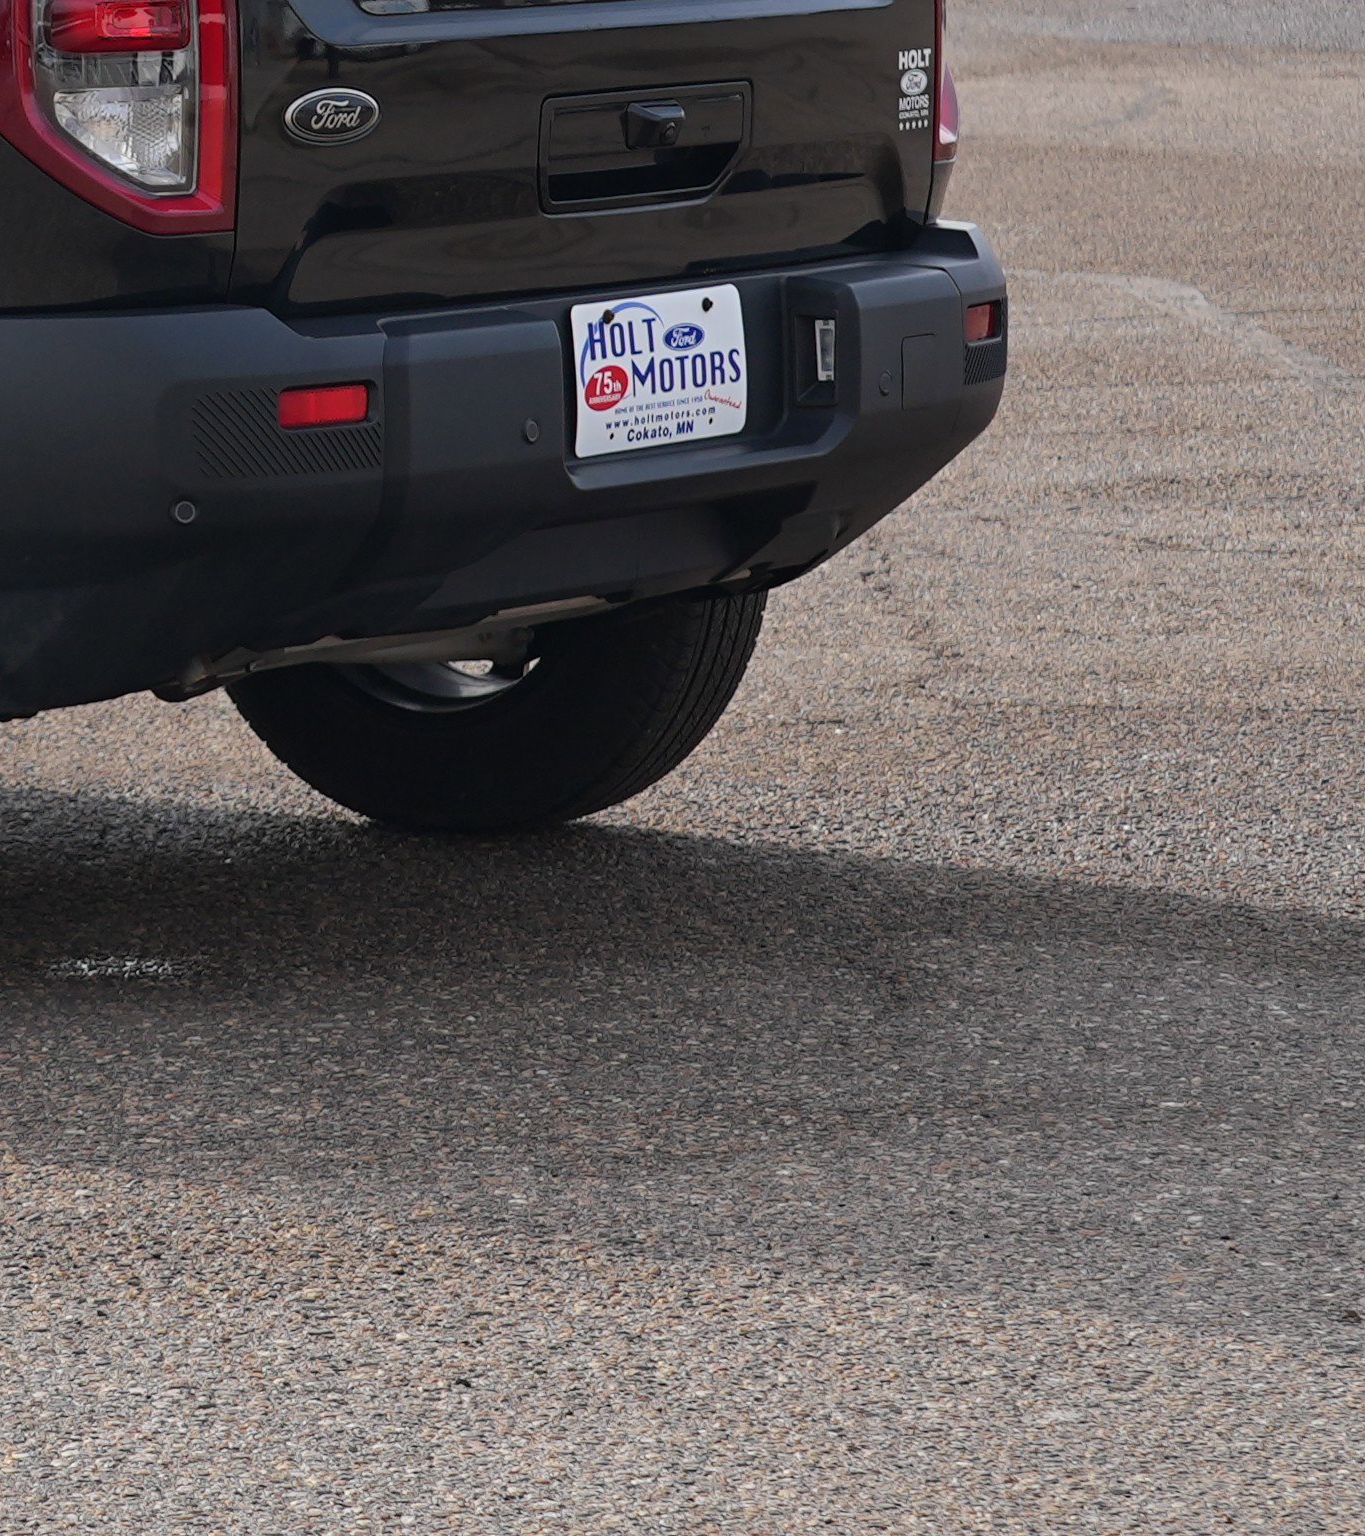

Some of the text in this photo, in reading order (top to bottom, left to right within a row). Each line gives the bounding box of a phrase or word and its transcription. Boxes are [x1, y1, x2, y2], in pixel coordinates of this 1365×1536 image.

[898, 48, 932, 70] HOLT
[899, 94, 930, 111] MOTORS
[311, 100, 362, 130] Ford
[587, 318, 657, 360] HOLT
[593, 370, 623, 395] 75th
[631, 348, 741, 397] MOTORS
[605, 406, 716, 429] www.holtmotors.com
[627, 419, 694, 442] Cokato, MN
